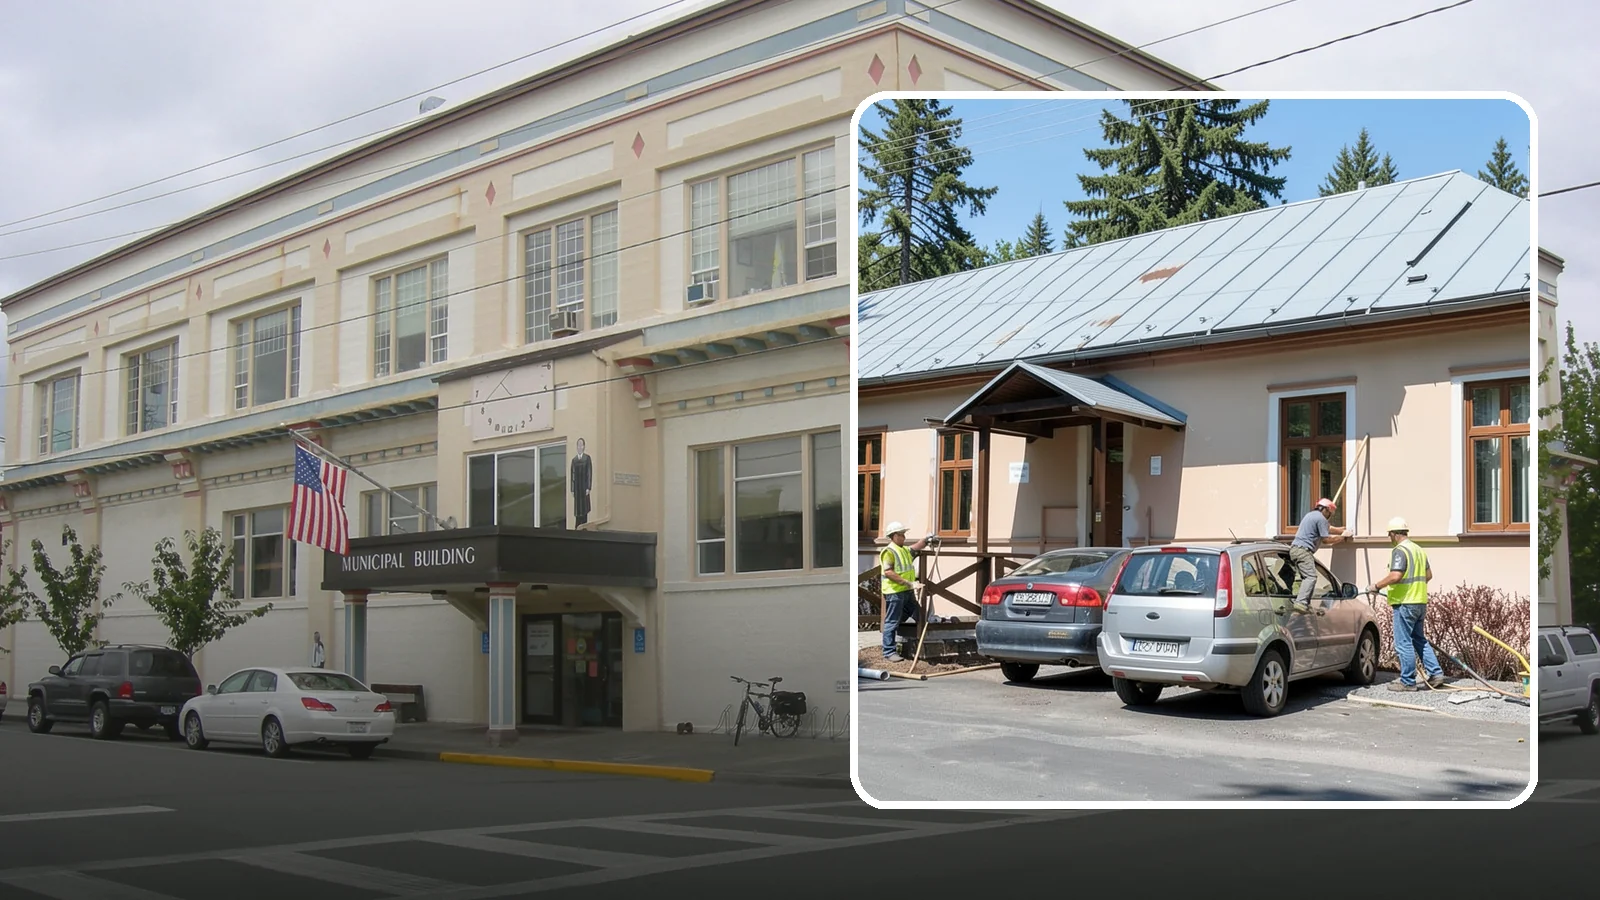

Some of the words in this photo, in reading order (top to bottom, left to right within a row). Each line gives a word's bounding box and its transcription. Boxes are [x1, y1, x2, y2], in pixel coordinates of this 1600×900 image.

[476, 390, 479, 398] 7
[480, 407, 485, 415] 8
[488, 418, 492, 426] 9
[521, 420, 526, 428] 2
[528, 414, 533, 422] 3
[342, 552, 405, 571] MUNICIPAL
[414, 546, 475, 567] BUILDING
